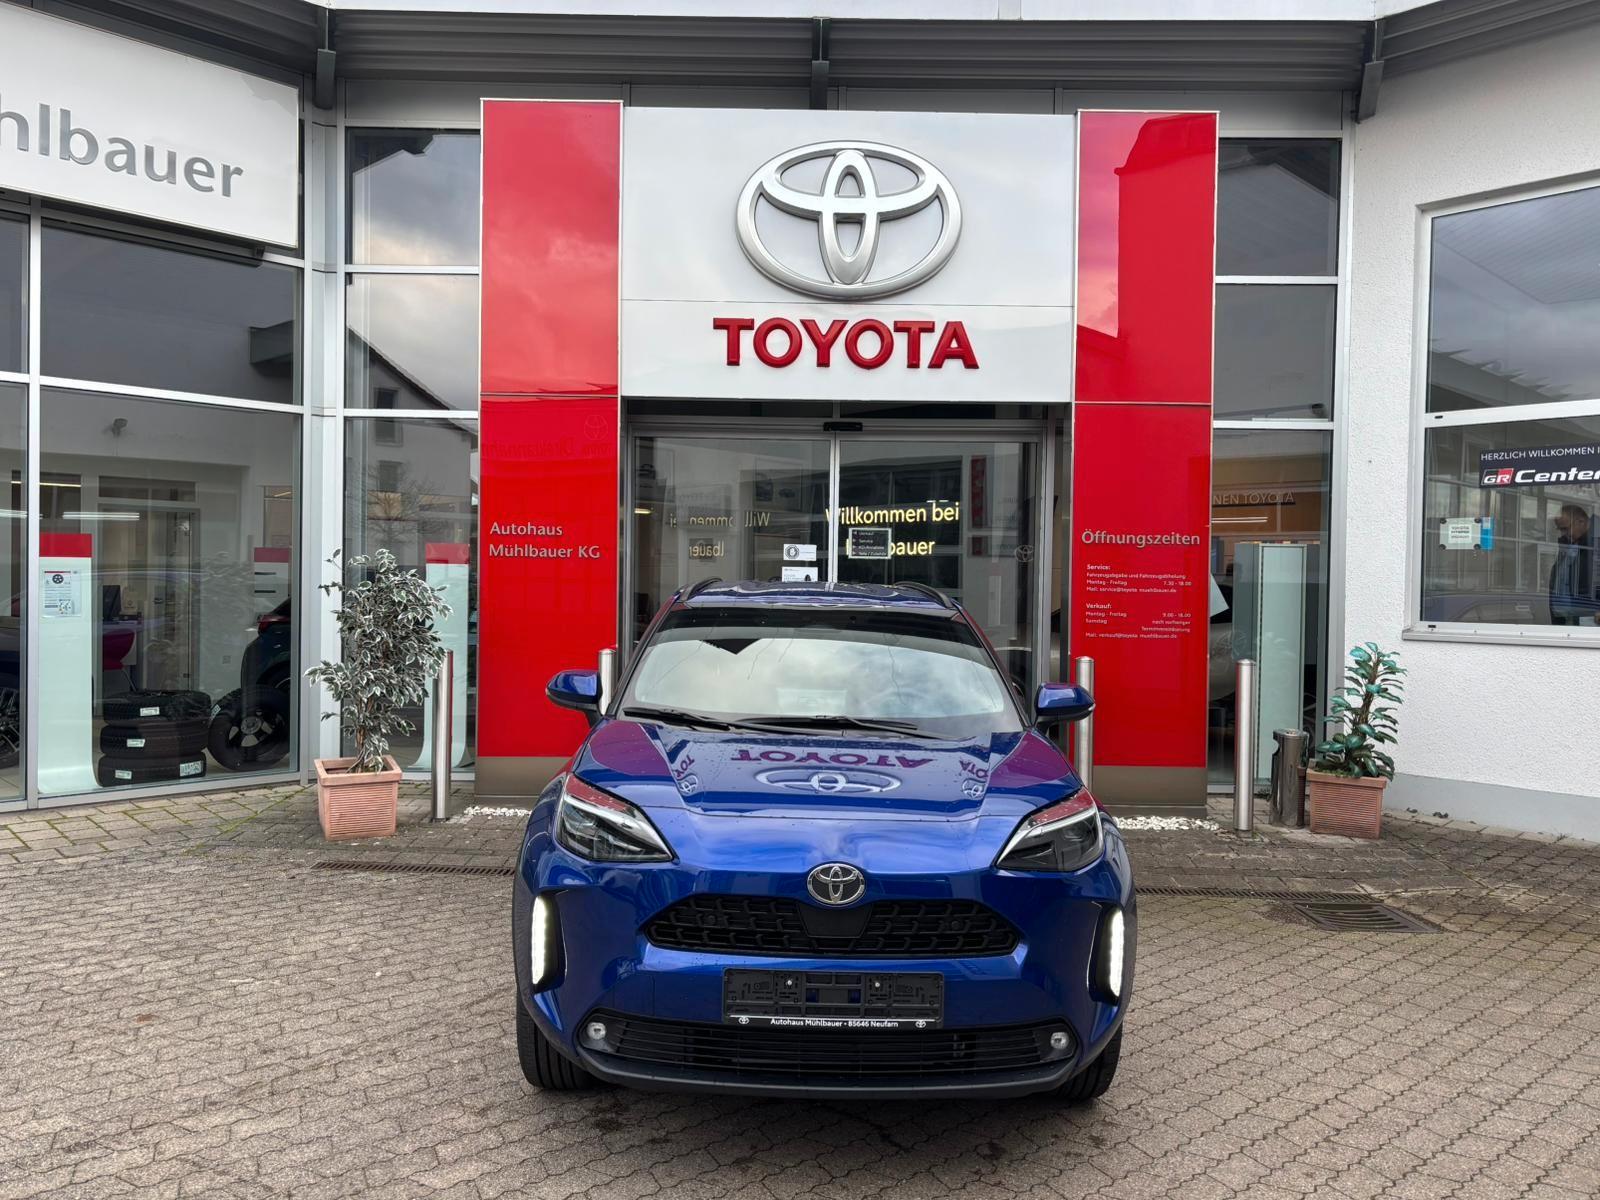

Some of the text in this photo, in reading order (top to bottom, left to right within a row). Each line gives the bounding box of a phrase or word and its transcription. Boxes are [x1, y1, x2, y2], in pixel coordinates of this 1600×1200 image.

[713, 317, 979, 370] TOYOTA
[1481, 450, 1526, 460] HERZLICH
[1529, 446, 1595, 457] WILLKOMMEN
[1243, 491, 1294, 504] TOYOTA
[825, 501, 960, 525] illkommen bei
[489, 522, 563, 536] Autohaus
[1081, 529, 1200, 548] Öffnungszeiten
[489, 543, 600, 559] Mühlbauer KG
[770, 1018, 804, 1027] Autohaus
[805, 1018, 843, 1027] Mühlbauer
[870, 1020, 899, 1028] Neufarn
